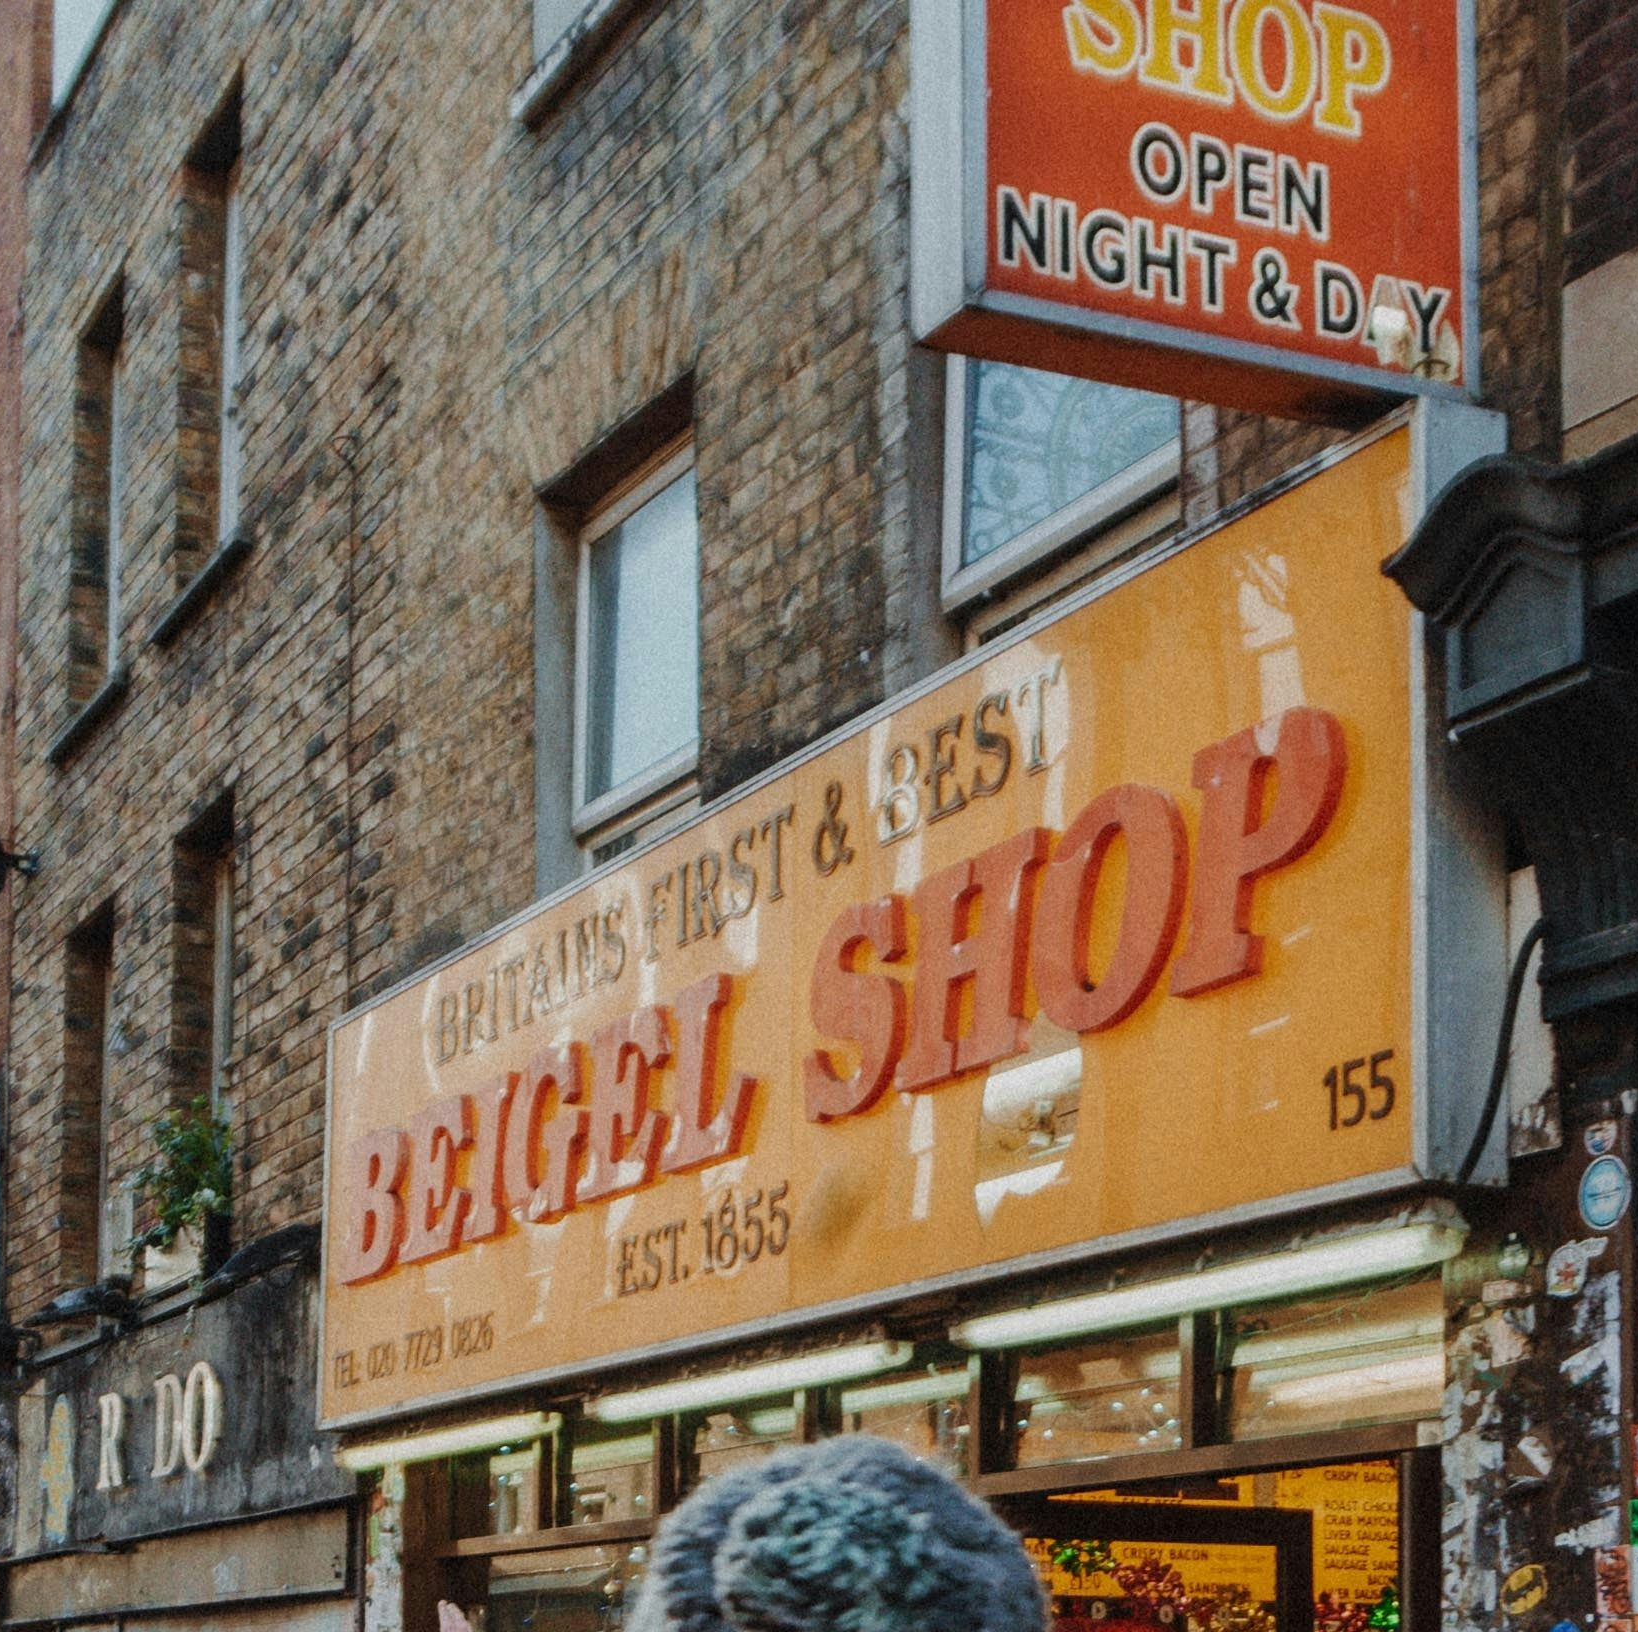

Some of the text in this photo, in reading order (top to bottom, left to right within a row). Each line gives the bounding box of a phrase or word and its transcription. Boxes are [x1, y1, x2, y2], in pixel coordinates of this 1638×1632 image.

[1063, 0, 1391, 138] SHOP
[1131, 122, 1329, 241] OPEN
[997, 185, 1451, 356] NIGHT & DAY
[646, 803, 795, 963] FIRST
[815, 780, 853, 907] &
[878, 656, 1063, 848] BEST
[336, 973, 759, 1286] BEIGEL
[803, 706, 1348, 1124] SHOP
[1323, 1048, 1395, 1131] 155
[618, 1180, 790, 1297] EST. 1855
[1169, 1548, 1208, 1560] BACON
[1357, 1530, 1398, 1541] SAUSAG
